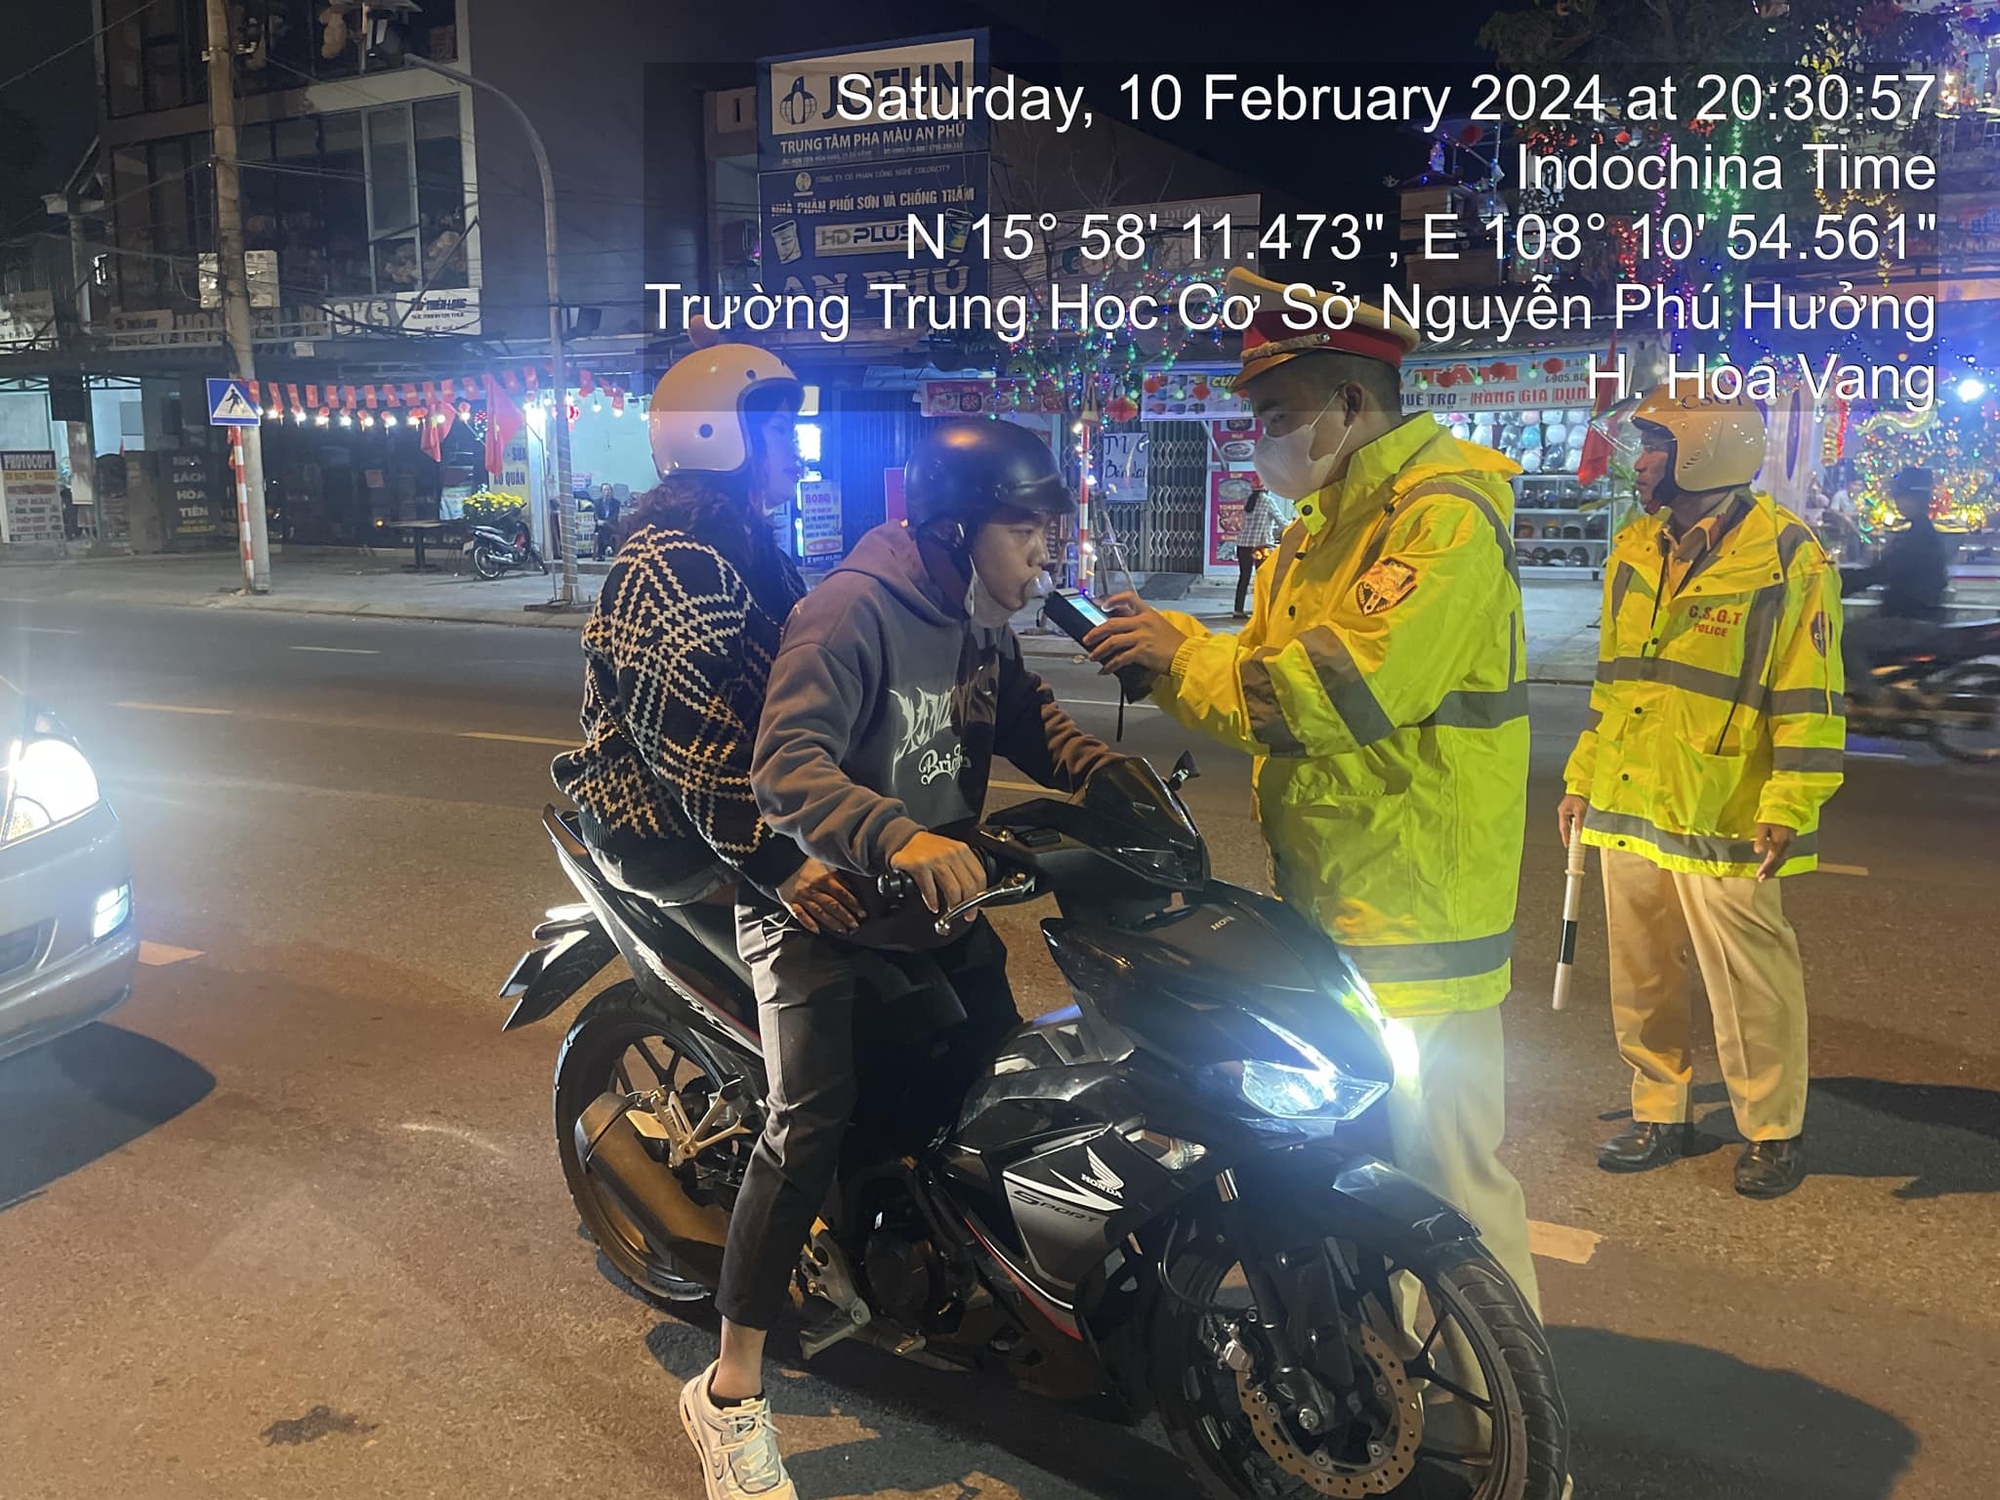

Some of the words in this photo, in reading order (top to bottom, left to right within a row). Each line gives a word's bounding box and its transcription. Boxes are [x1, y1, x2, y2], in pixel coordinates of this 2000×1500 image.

[780, 137, 822, 154] TRUNG
[824, 132, 851, 149] TÂM
[853, 131, 879, 147] PHA
[883, 127, 912, 144] MÀU
[915, 126, 935, 141] AN
[937, 120, 965, 138] PHÚ
[829, 193, 854, 212] PHỐI
[857, 193, 880, 209] SƠN
[883, 190, 897, 208] VÀ
[899, 187, 938, 206] CHỐNG
[1519, 388, 1548, 404] GIA
[3, 453, 53, 470] PHOTOCOPY
[1688, 604, 1743, 626] C.S.G.T
[1693, 623, 1729, 638] POLICE
[1081, 1173, 1125, 1200] HONDA
[1010, 1189, 1102, 1223] SPORT
